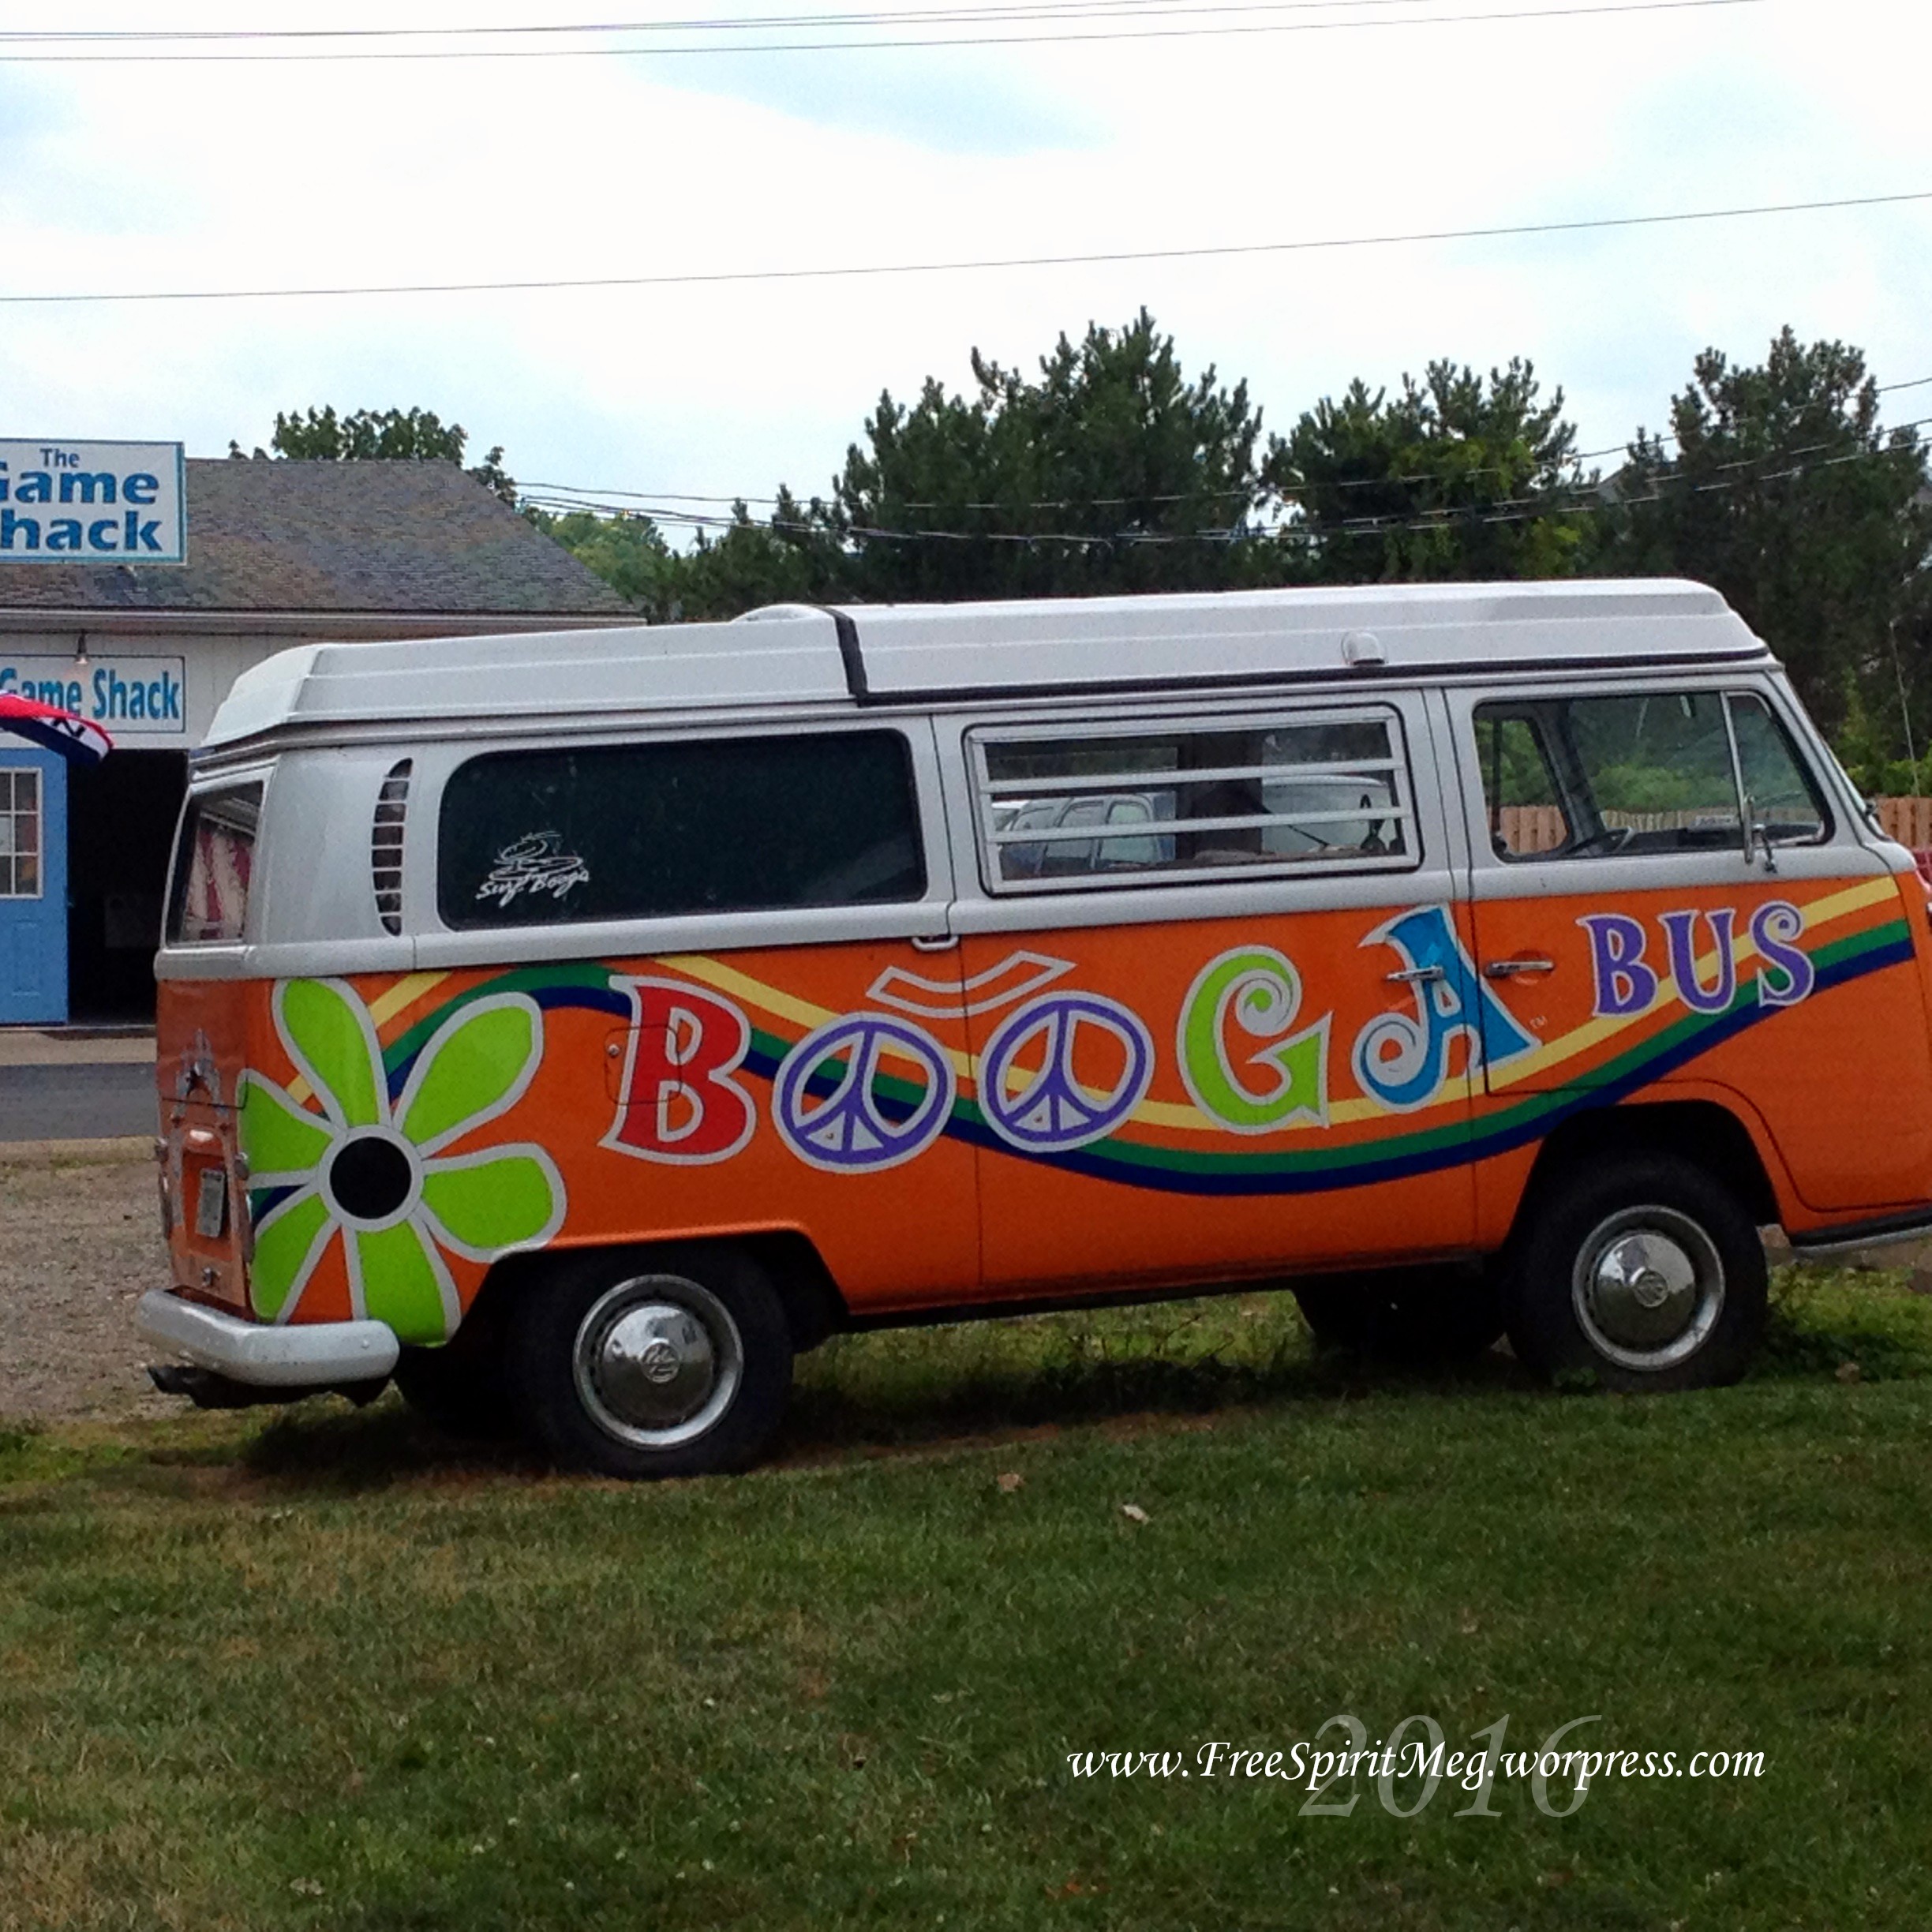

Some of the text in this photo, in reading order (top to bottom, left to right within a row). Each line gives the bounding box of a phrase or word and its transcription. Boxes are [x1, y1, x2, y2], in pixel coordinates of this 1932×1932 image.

[40, 447, 80, 467] The
[0, 460, 159, 504] ame
[0, 508, 163, 551] hack
[92, 668, 181, 720] Shack
[1576, 900, 1816, 1019] BUS
